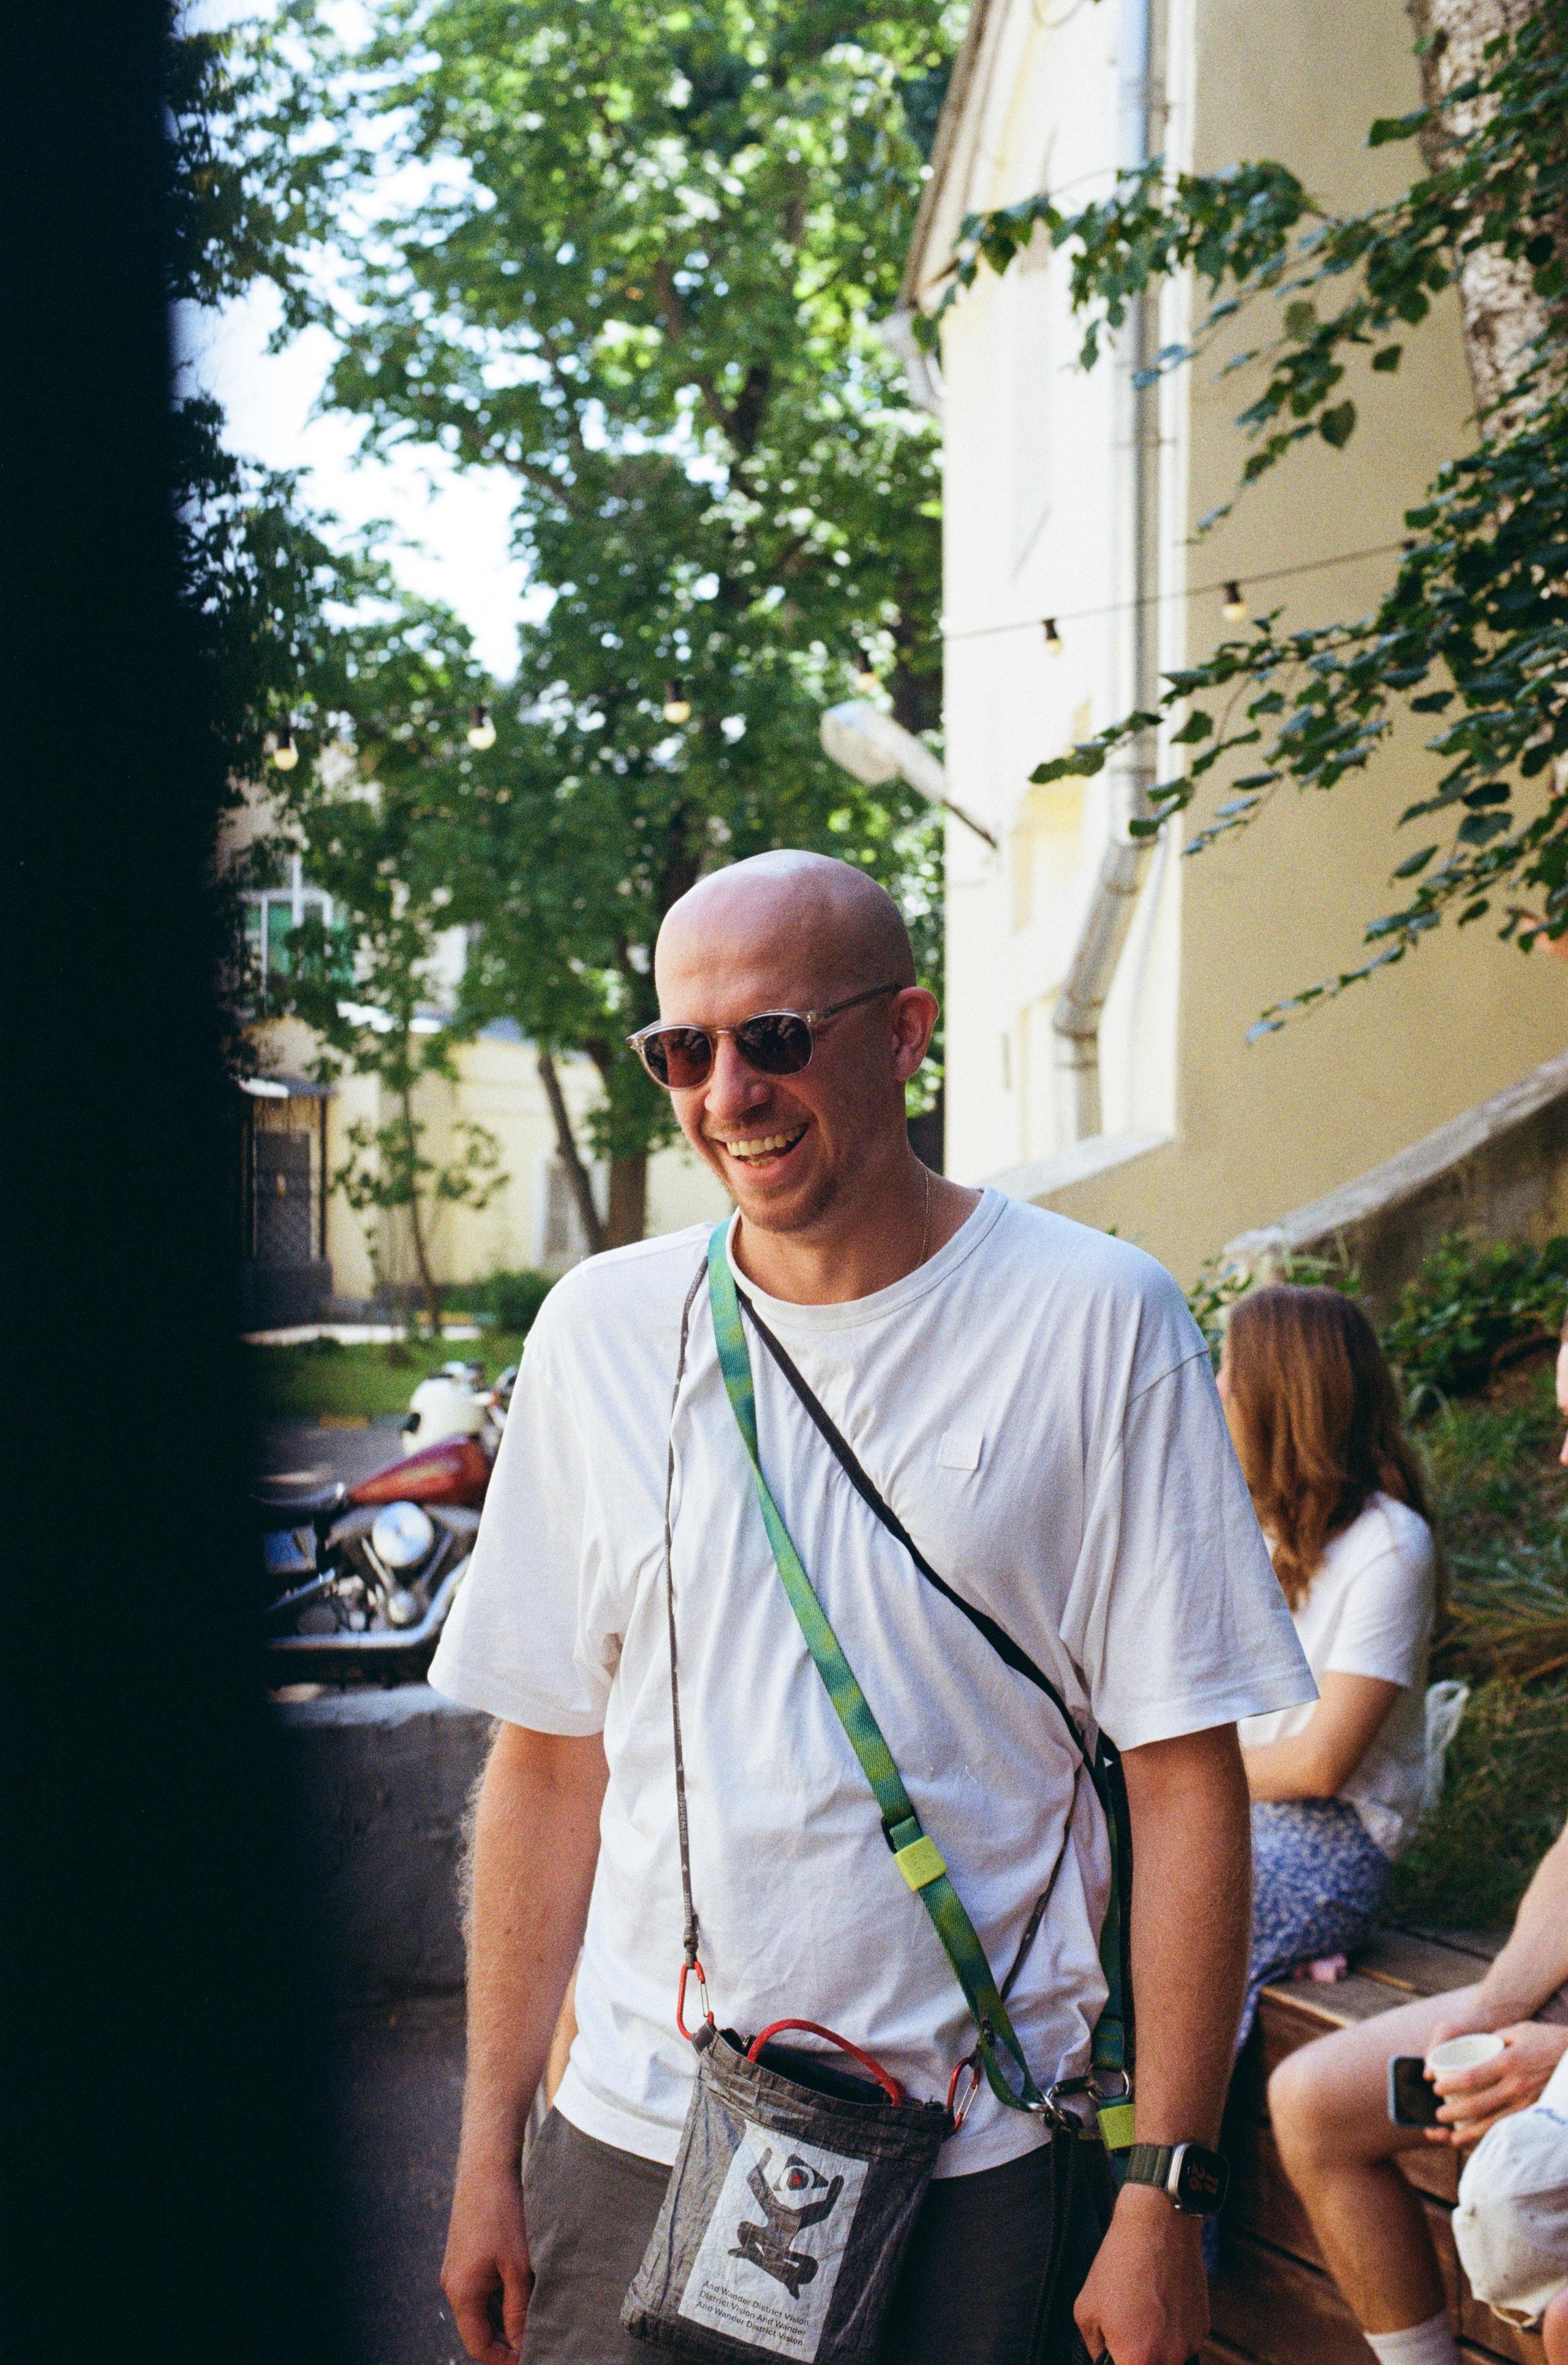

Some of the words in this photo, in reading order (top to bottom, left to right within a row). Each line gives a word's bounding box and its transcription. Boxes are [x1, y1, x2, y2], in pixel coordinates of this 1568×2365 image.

[678, 1790, 687, 1830] wander
[696, 2301, 713, 2313] And
[715, 2307, 744, 2325] Wander
[747, 2320, 776, 2337] District
[778, 2331, 804, 2346] Vision
[699, 2290, 729, 2307] District
[731, 2303, 755, 2318] Vision
[756, 2314, 774, 2325] And
[775, 2320, 806, 2336] Wander
[703, 2280, 721, 2293] And
[722, 2287, 751, 2306] Wander
[753, 2300, 782, 2317] District
[785, 2312, 809, 2326] Vision
